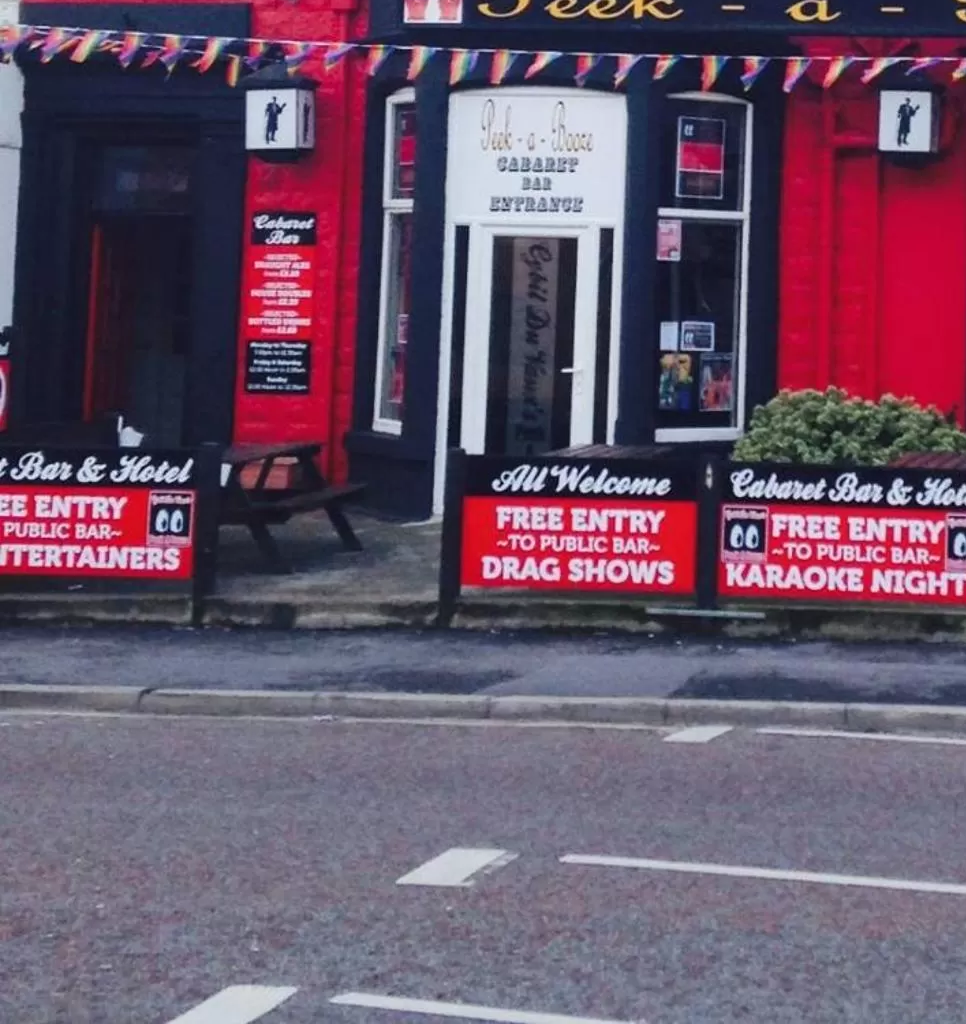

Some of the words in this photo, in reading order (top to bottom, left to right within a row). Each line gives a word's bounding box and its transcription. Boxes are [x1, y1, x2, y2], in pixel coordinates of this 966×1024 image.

[785, 0, 841, 22] a
[497, 157, 580, 174] CABARET
[521, 176, 552, 191] BAR
[489, 196, 584, 213] ENTRANCE
[253, 214, 315, 230] Cabaret
[265, 230, 301, 245] Bar
[10, 451, 73, 480] Bar
[77, 456, 107, 483] &
[110, 456, 194, 483] Hotel
[492, 465, 546, 492] All
[550, 465, 672, 496] Welcome
[730, 469, 827, 501] Cabaret
[828, 472, 884, 505] Bar
[886, 478, 913, 505] &
[34, 495, 128, 519] ENTRY
[4, 522, 70, 538] PUBLIC
[496, 506, 564, 531] FREE
[571, 507, 666, 534] ENTRY
[771, 513, 841, 539] FREE
[848, 516, 945, 544] ENTRY
[540, 536, 608, 553] PUBLIC
[816, 544, 886, 563] PUBLIC
[481, 556, 561, 581] DRAG
[568, 559, 675, 585] SHOWS
[725, 563, 864, 592] KARAOKE
